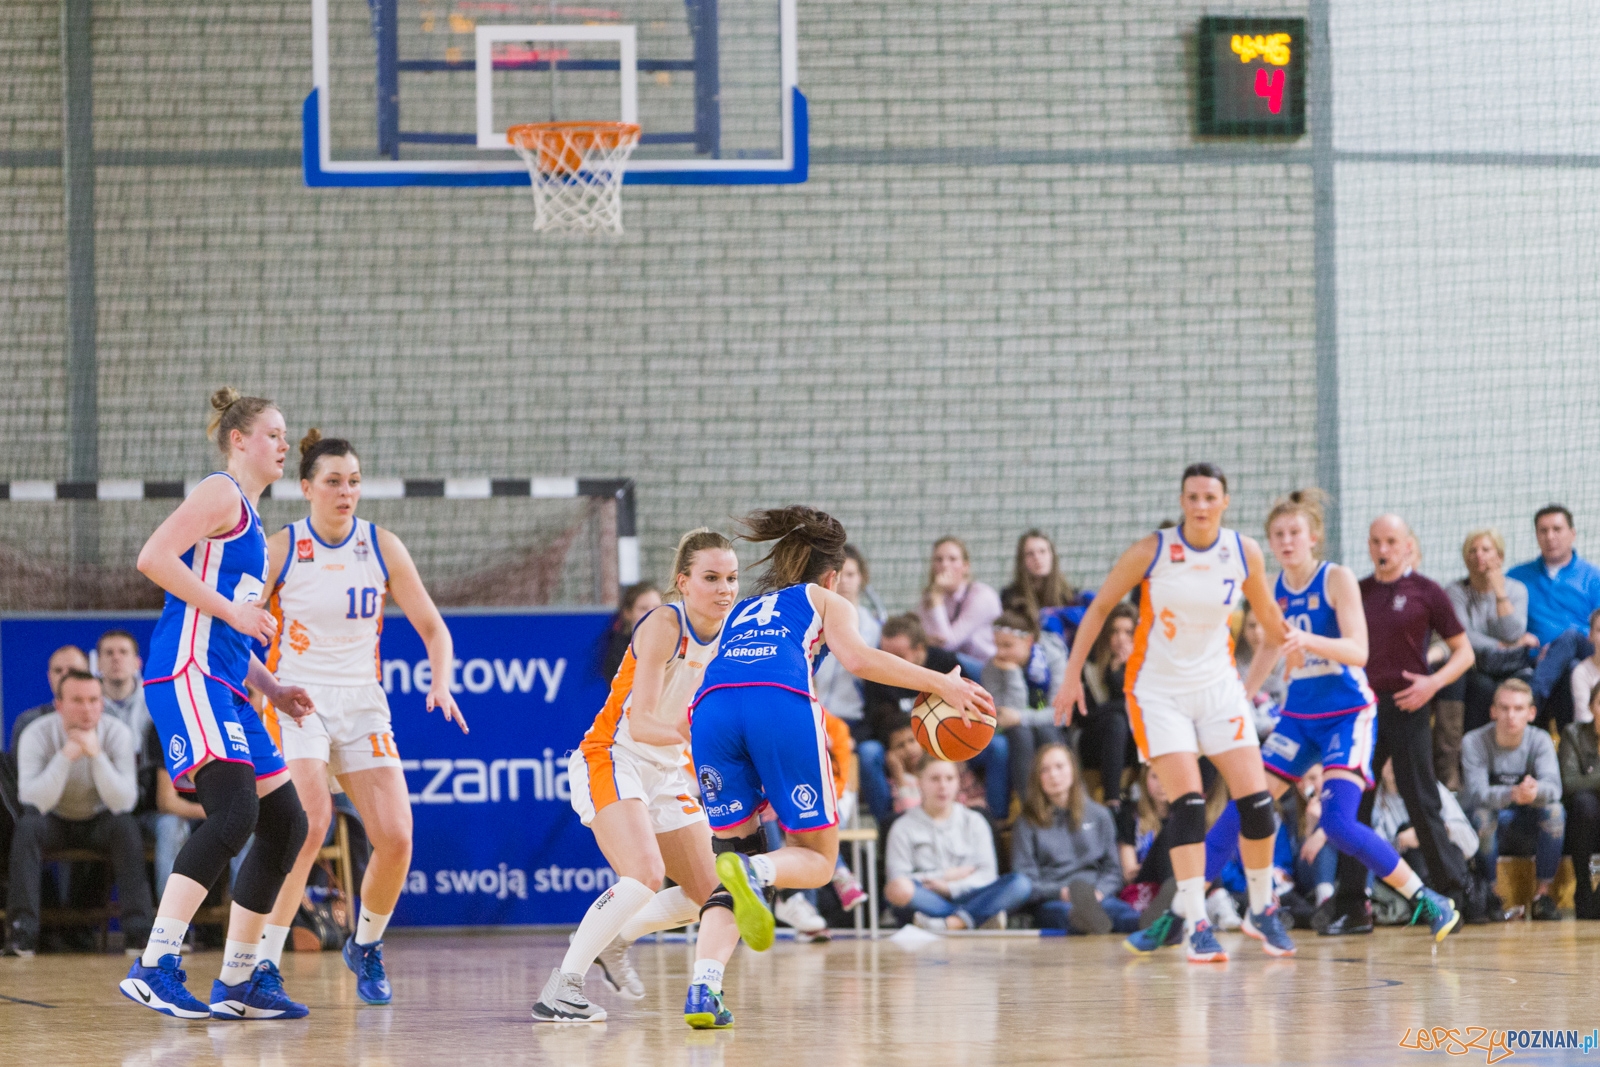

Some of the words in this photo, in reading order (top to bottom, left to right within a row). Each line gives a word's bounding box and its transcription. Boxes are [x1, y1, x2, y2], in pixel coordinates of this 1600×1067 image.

[1254, 67, 1285, 114] 4
[346, 586, 378, 619] 10
[1223, 579, 1235, 605] 7
[731, 593, 781, 628] 4
[723, 645, 779, 658] AGROBEX
[1229, 715, 1245, 741] 7
[435, 861, 528, 899] swoją
